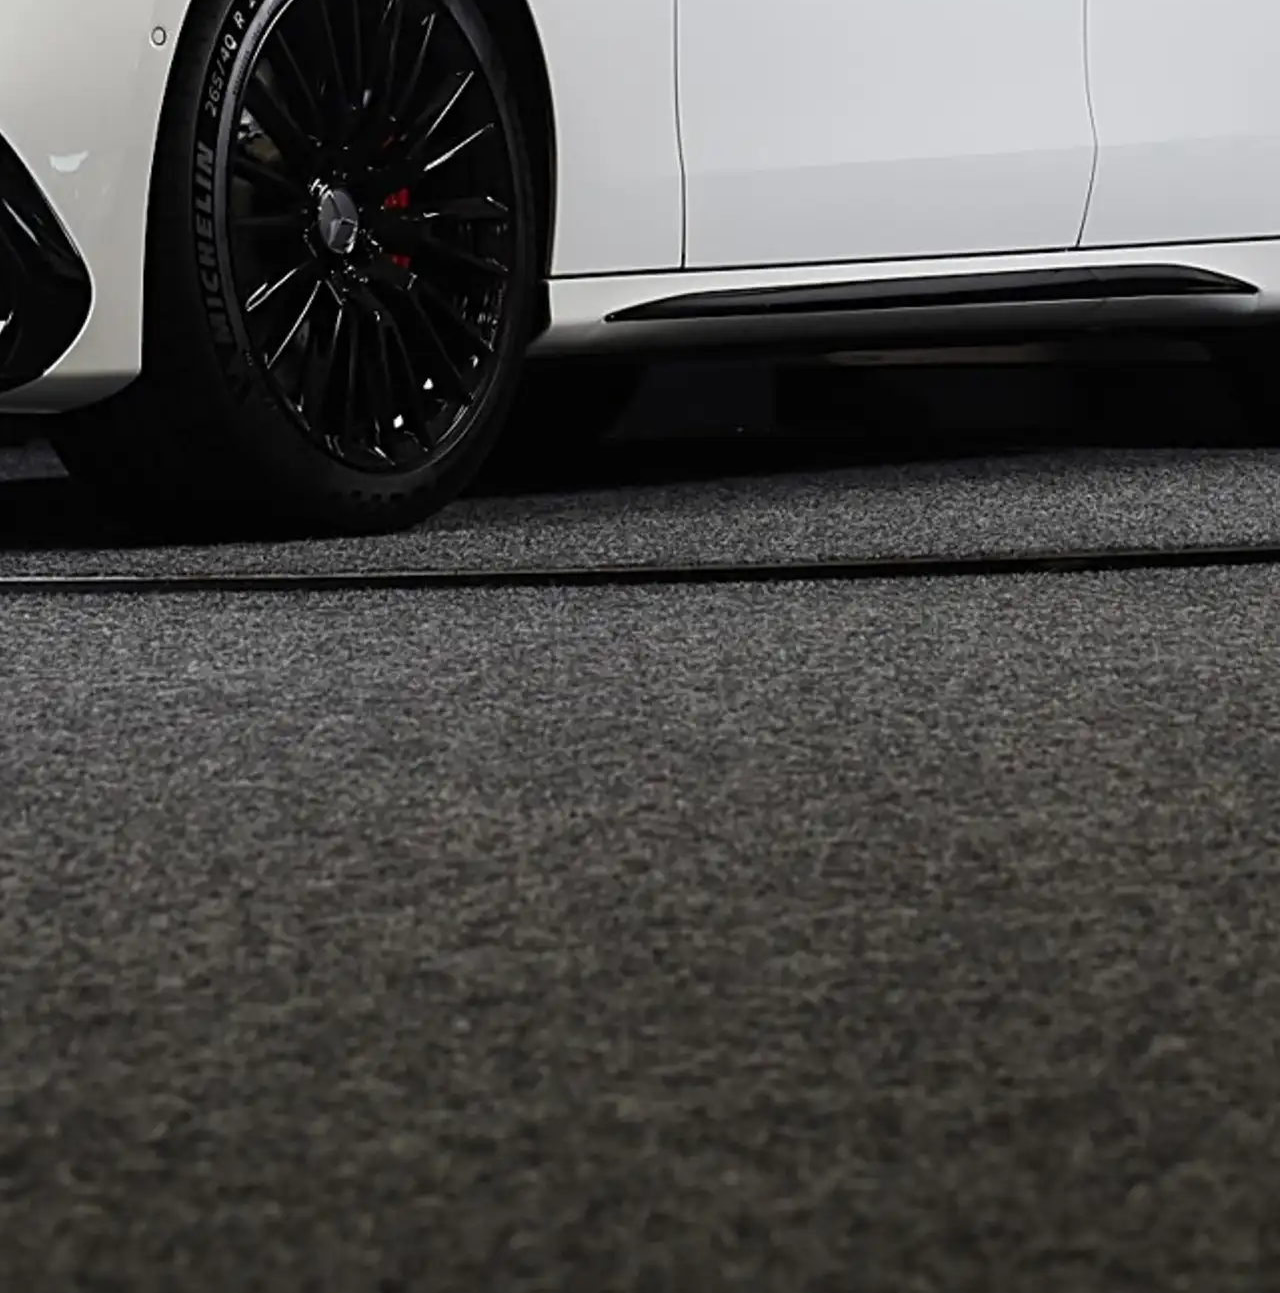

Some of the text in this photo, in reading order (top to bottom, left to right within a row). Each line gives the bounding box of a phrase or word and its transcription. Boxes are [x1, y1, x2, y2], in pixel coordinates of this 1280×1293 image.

[204, 33, 238, 119] 265/40
[232, 9, 246, 30] R
[195, 140, 233, 345] MICHELIN
